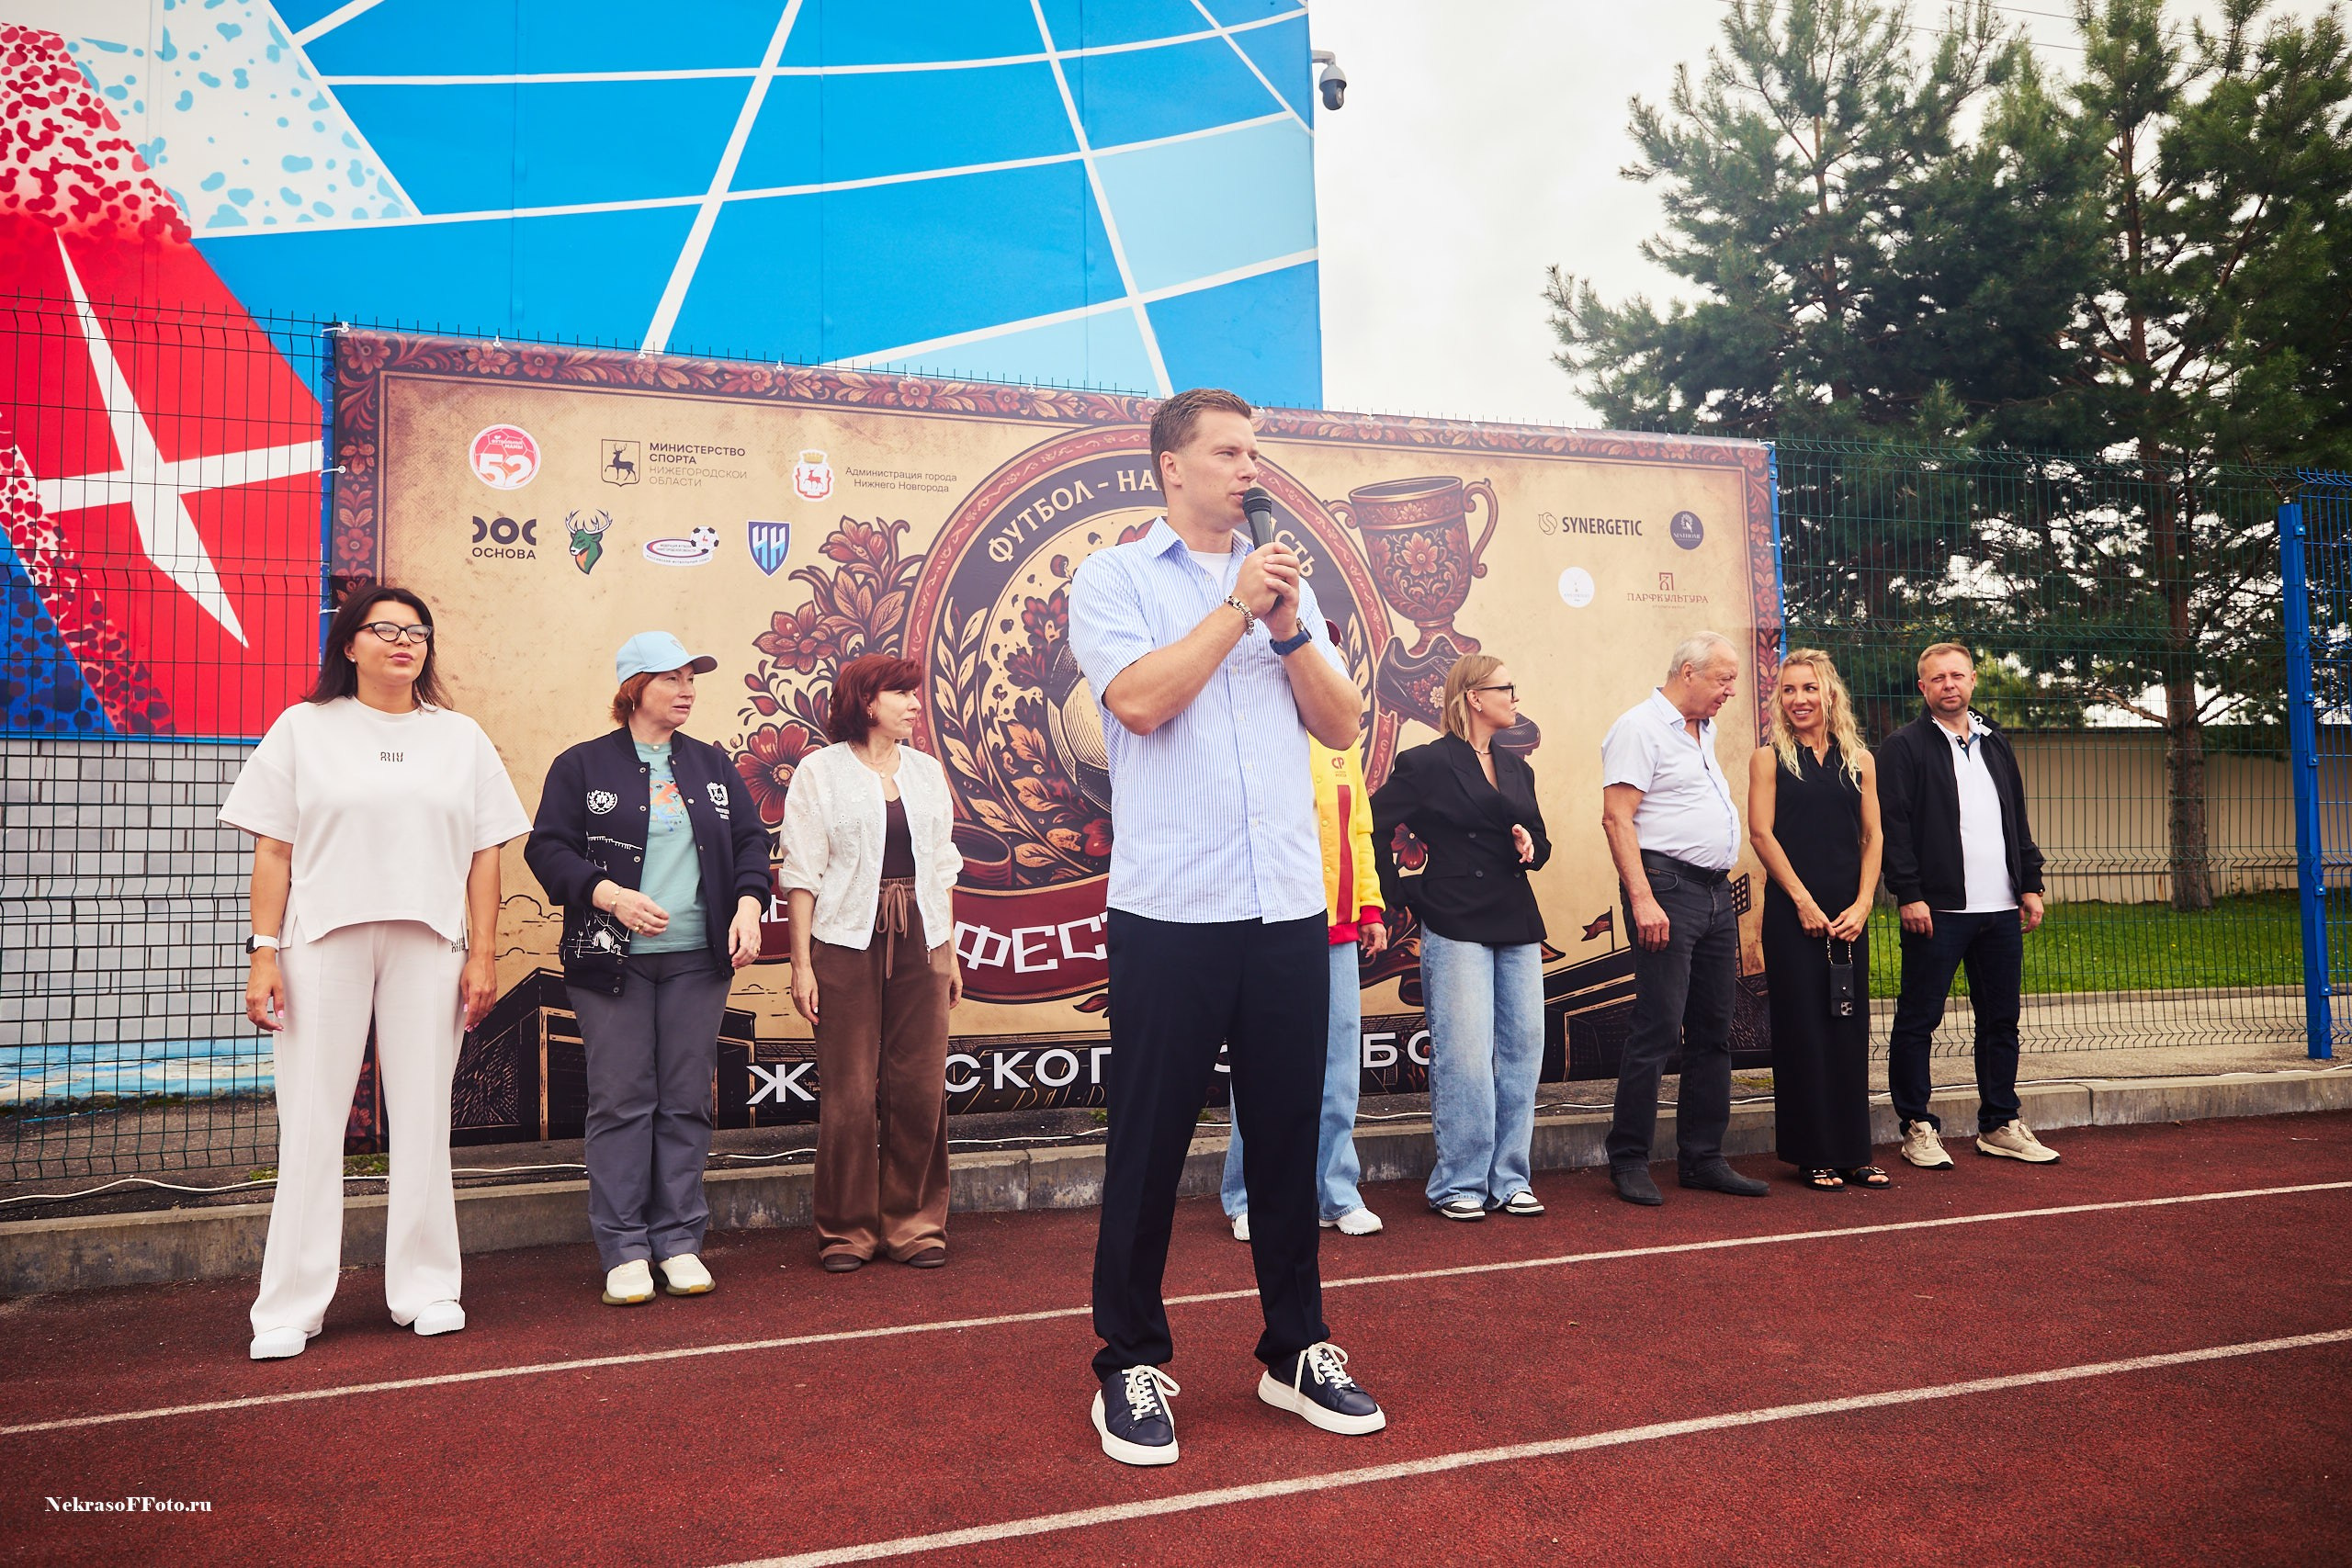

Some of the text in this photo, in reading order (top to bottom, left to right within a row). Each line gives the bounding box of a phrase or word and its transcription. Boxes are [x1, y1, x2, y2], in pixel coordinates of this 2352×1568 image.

[650, 442, 746, 457] МИНИСТЕРСТВО
[649, 453, 697, 465] СПОРТА
[478, 453, 535, 488] 52
[845, 467, 957, 482] Администрация города
[649, 476, 702, 487] ОБЛАСТИ
[854, 479, 949, 492] Нижнего Новгорода
[989, 479, 1095, 563] ФУТБОЛ
[1562, 516, 1643, 536] SYNERGETIC
[471, 547, 537, 559] ОСНОВА
[1626, 592, 1710, 604] ПАРФКУЛЬТУРА
